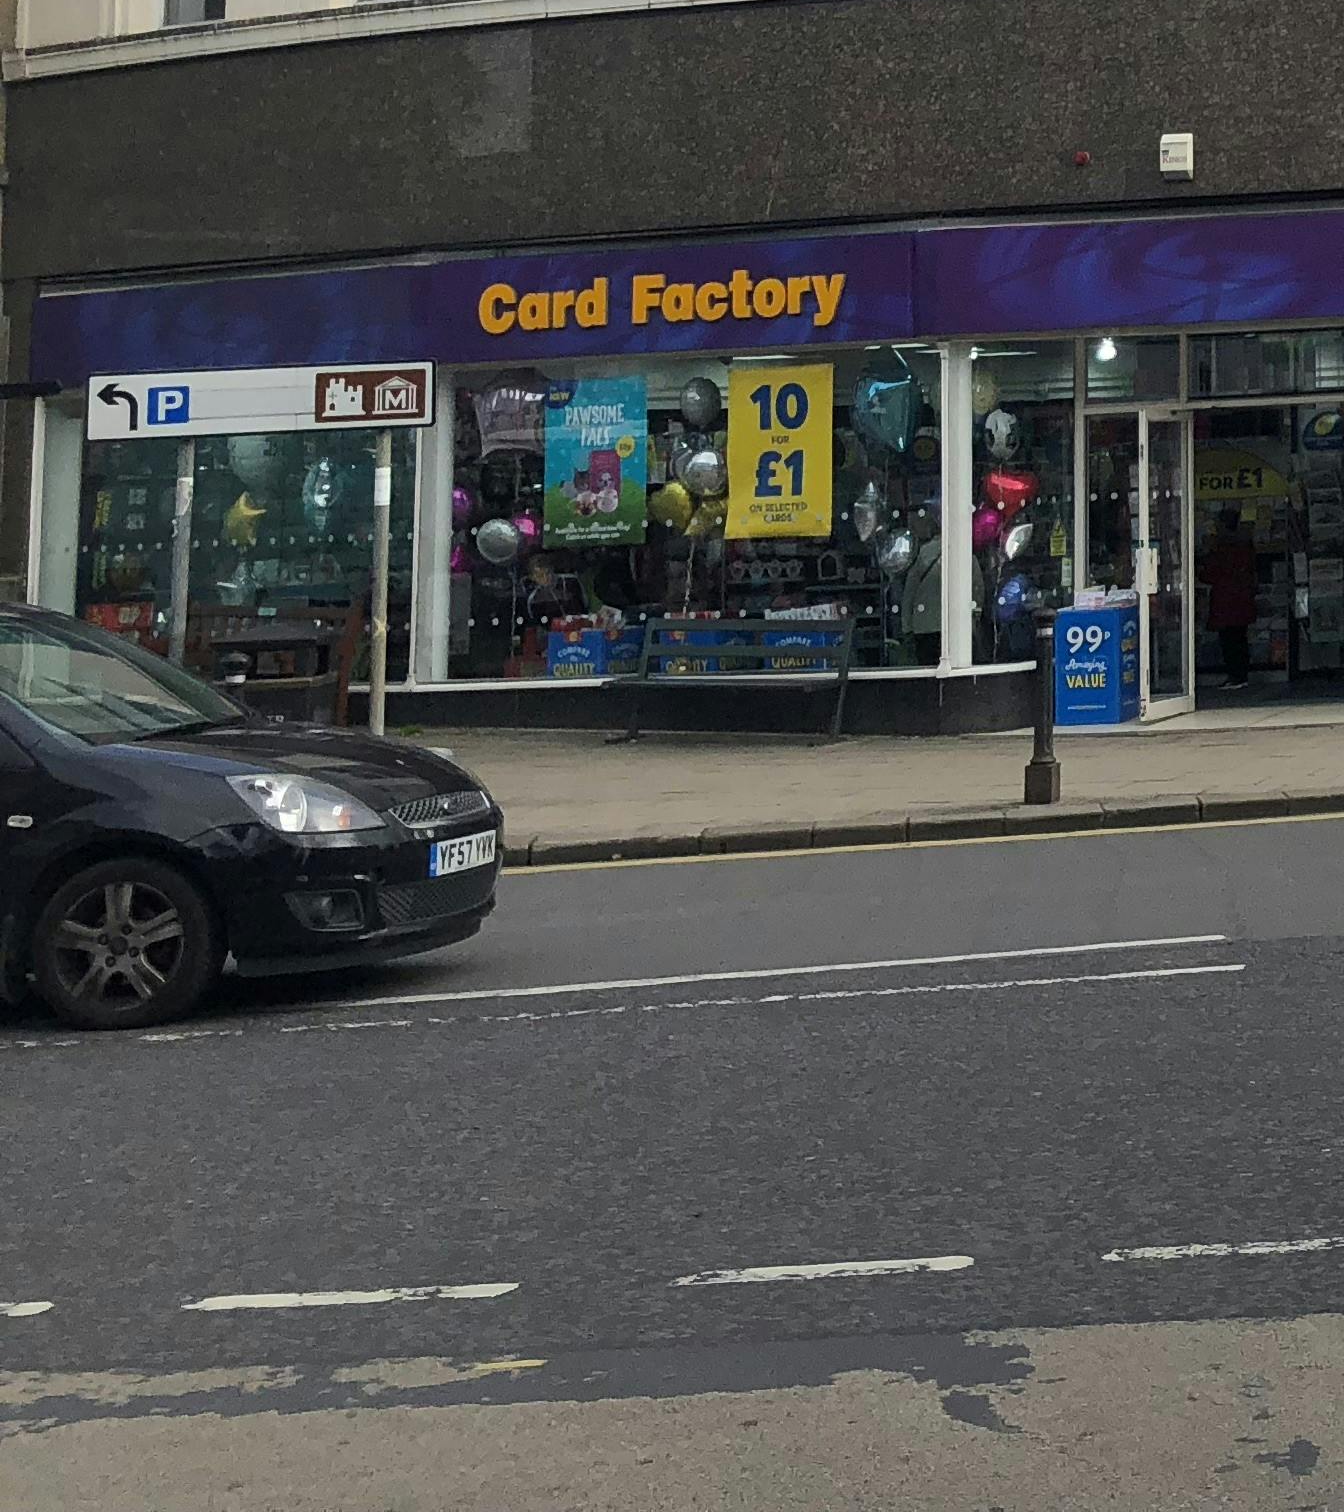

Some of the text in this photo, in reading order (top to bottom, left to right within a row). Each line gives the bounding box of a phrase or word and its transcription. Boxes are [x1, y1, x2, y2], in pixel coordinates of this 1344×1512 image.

[478, 269, 846, 335] Card Factory
[157, 389, 407, 421] P M
[564, 402, 625, 426] PAWSOME
[749, 382, 809, 430] 10
[771, 435, 790, 445] FOR
[754, 449, 804, 498] £1
[1200, 467, 1263, 490] FOR £1
[749, 502, 808, 513] ON SELECTED
[1065, 673, 1107, 689] VALUE
[440, 839, 473, 870] YF57
